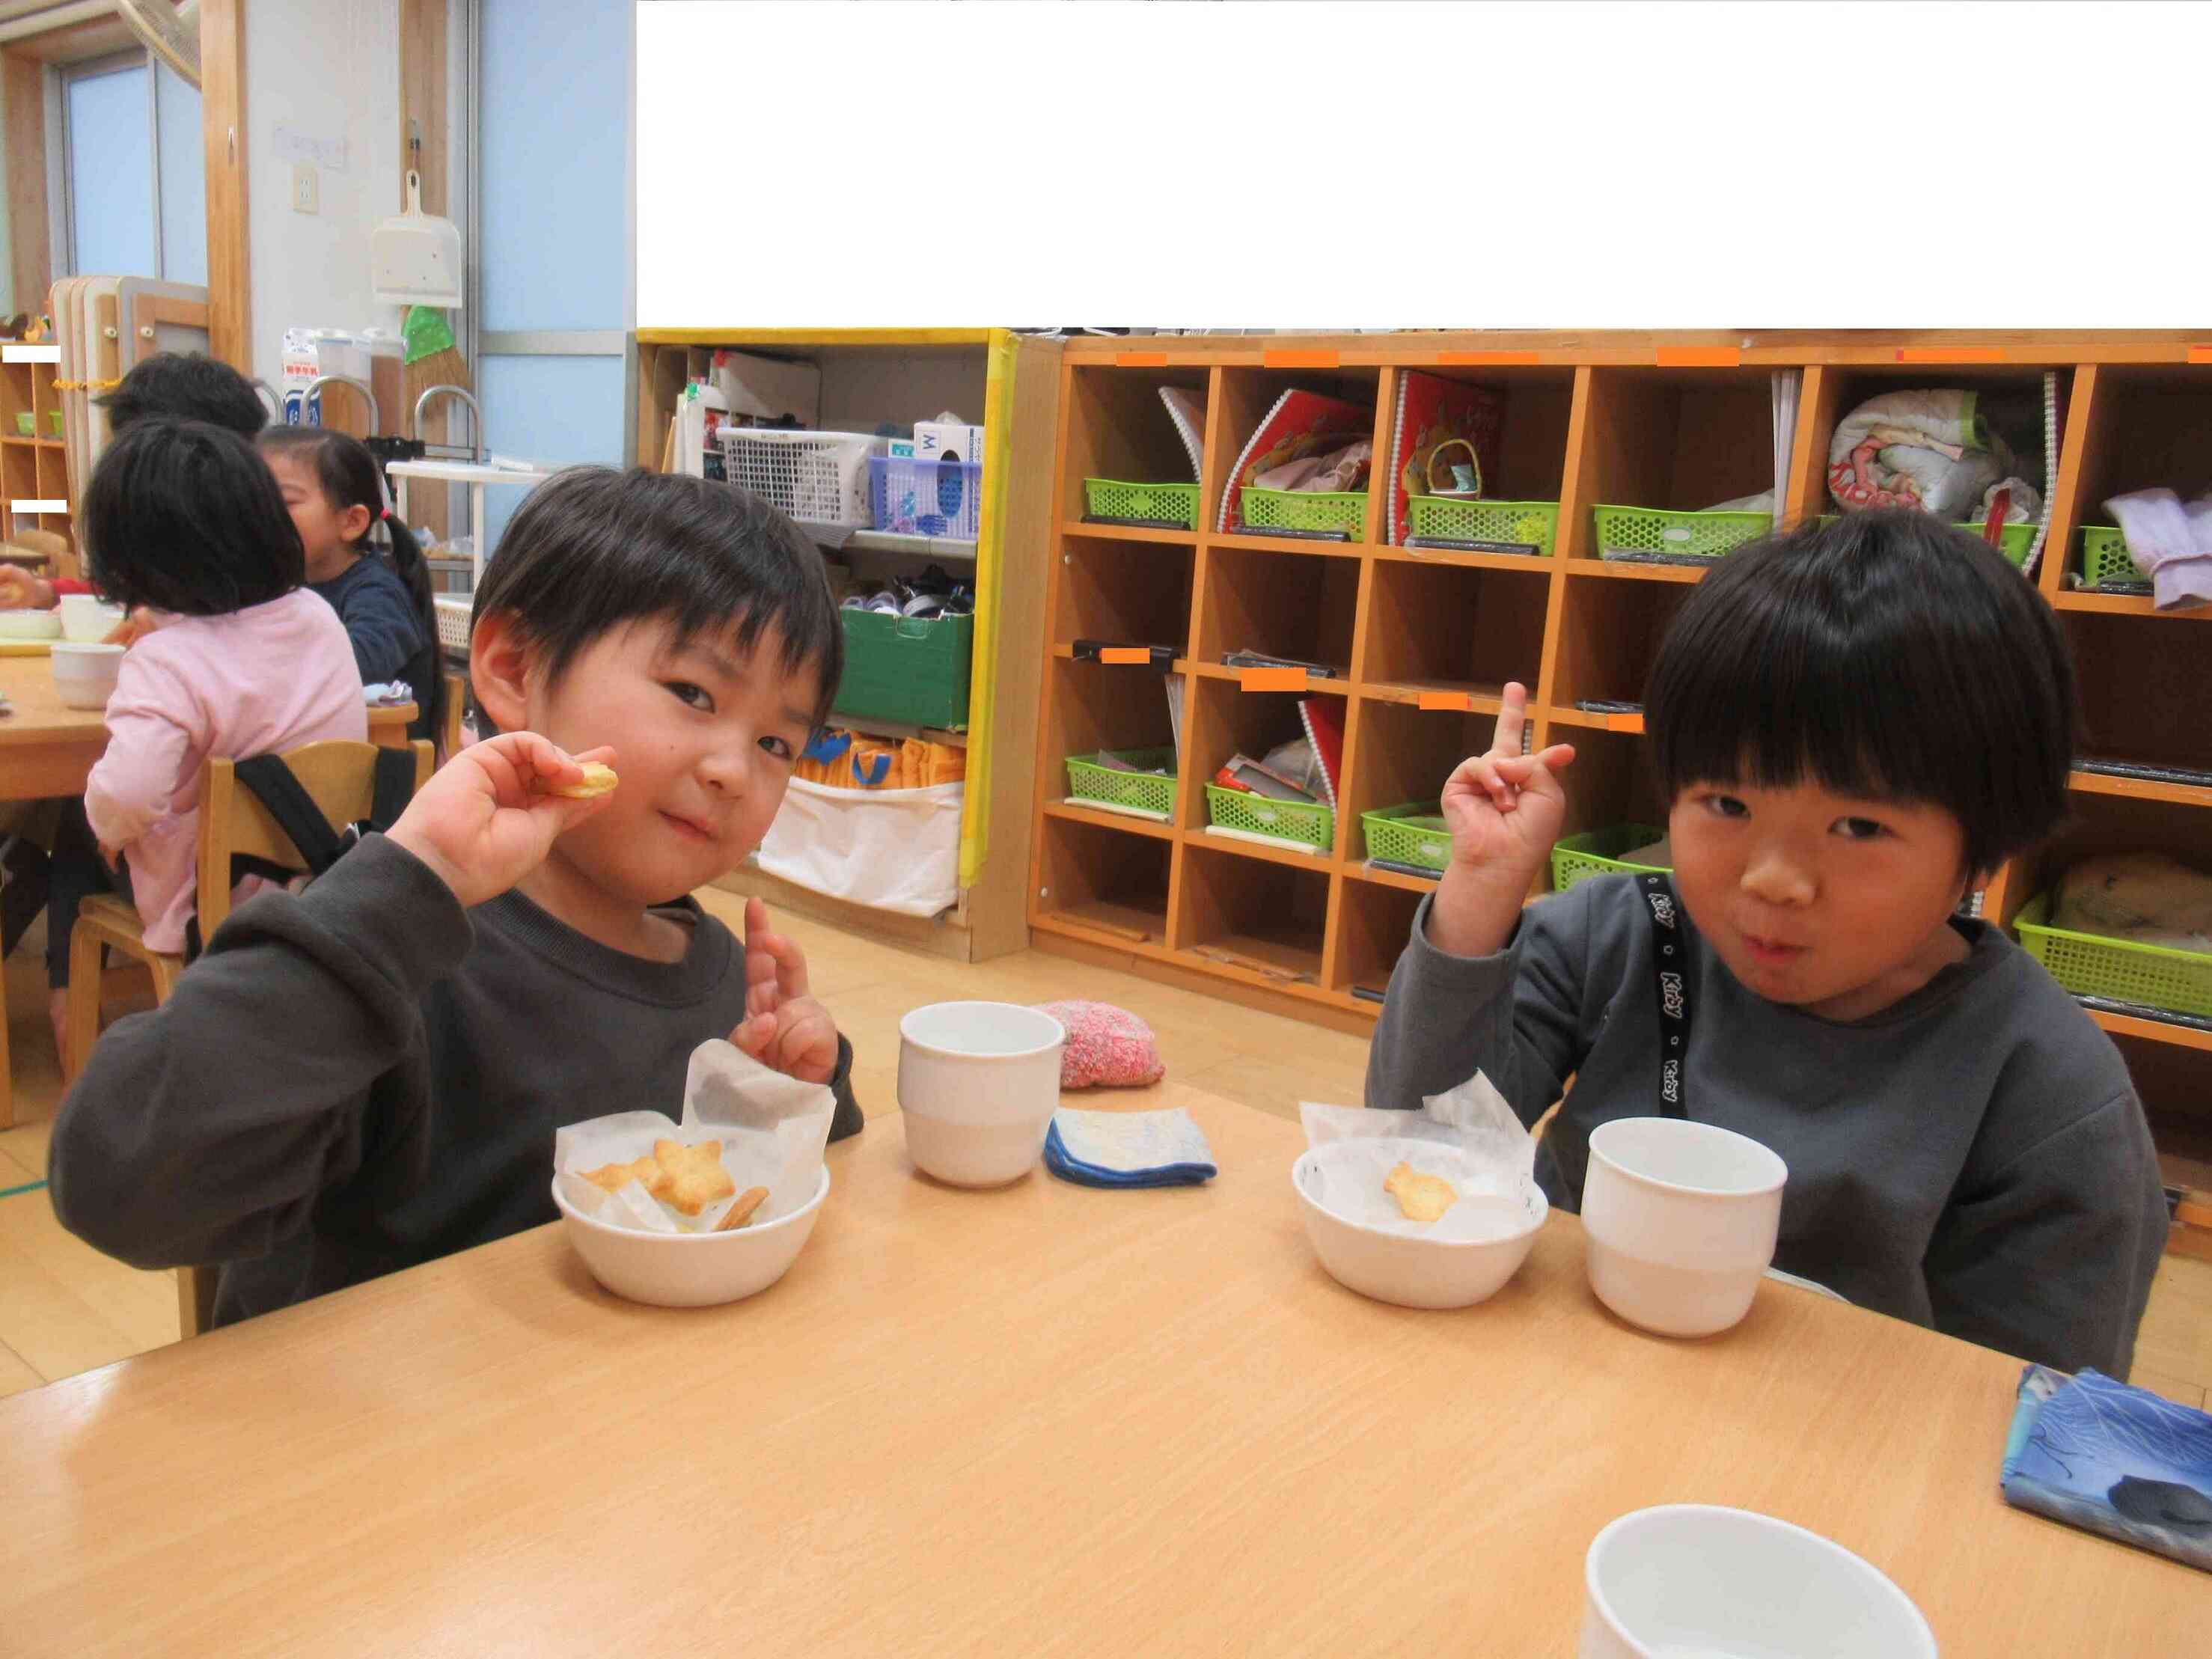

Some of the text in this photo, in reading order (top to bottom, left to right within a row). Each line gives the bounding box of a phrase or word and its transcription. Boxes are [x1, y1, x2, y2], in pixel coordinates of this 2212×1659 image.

[1648, 892, 1676, 929] Kirby
[1660, 971, 1684, 1019] Kirby
[1661, 1059, 1678, 1103] Kirby
